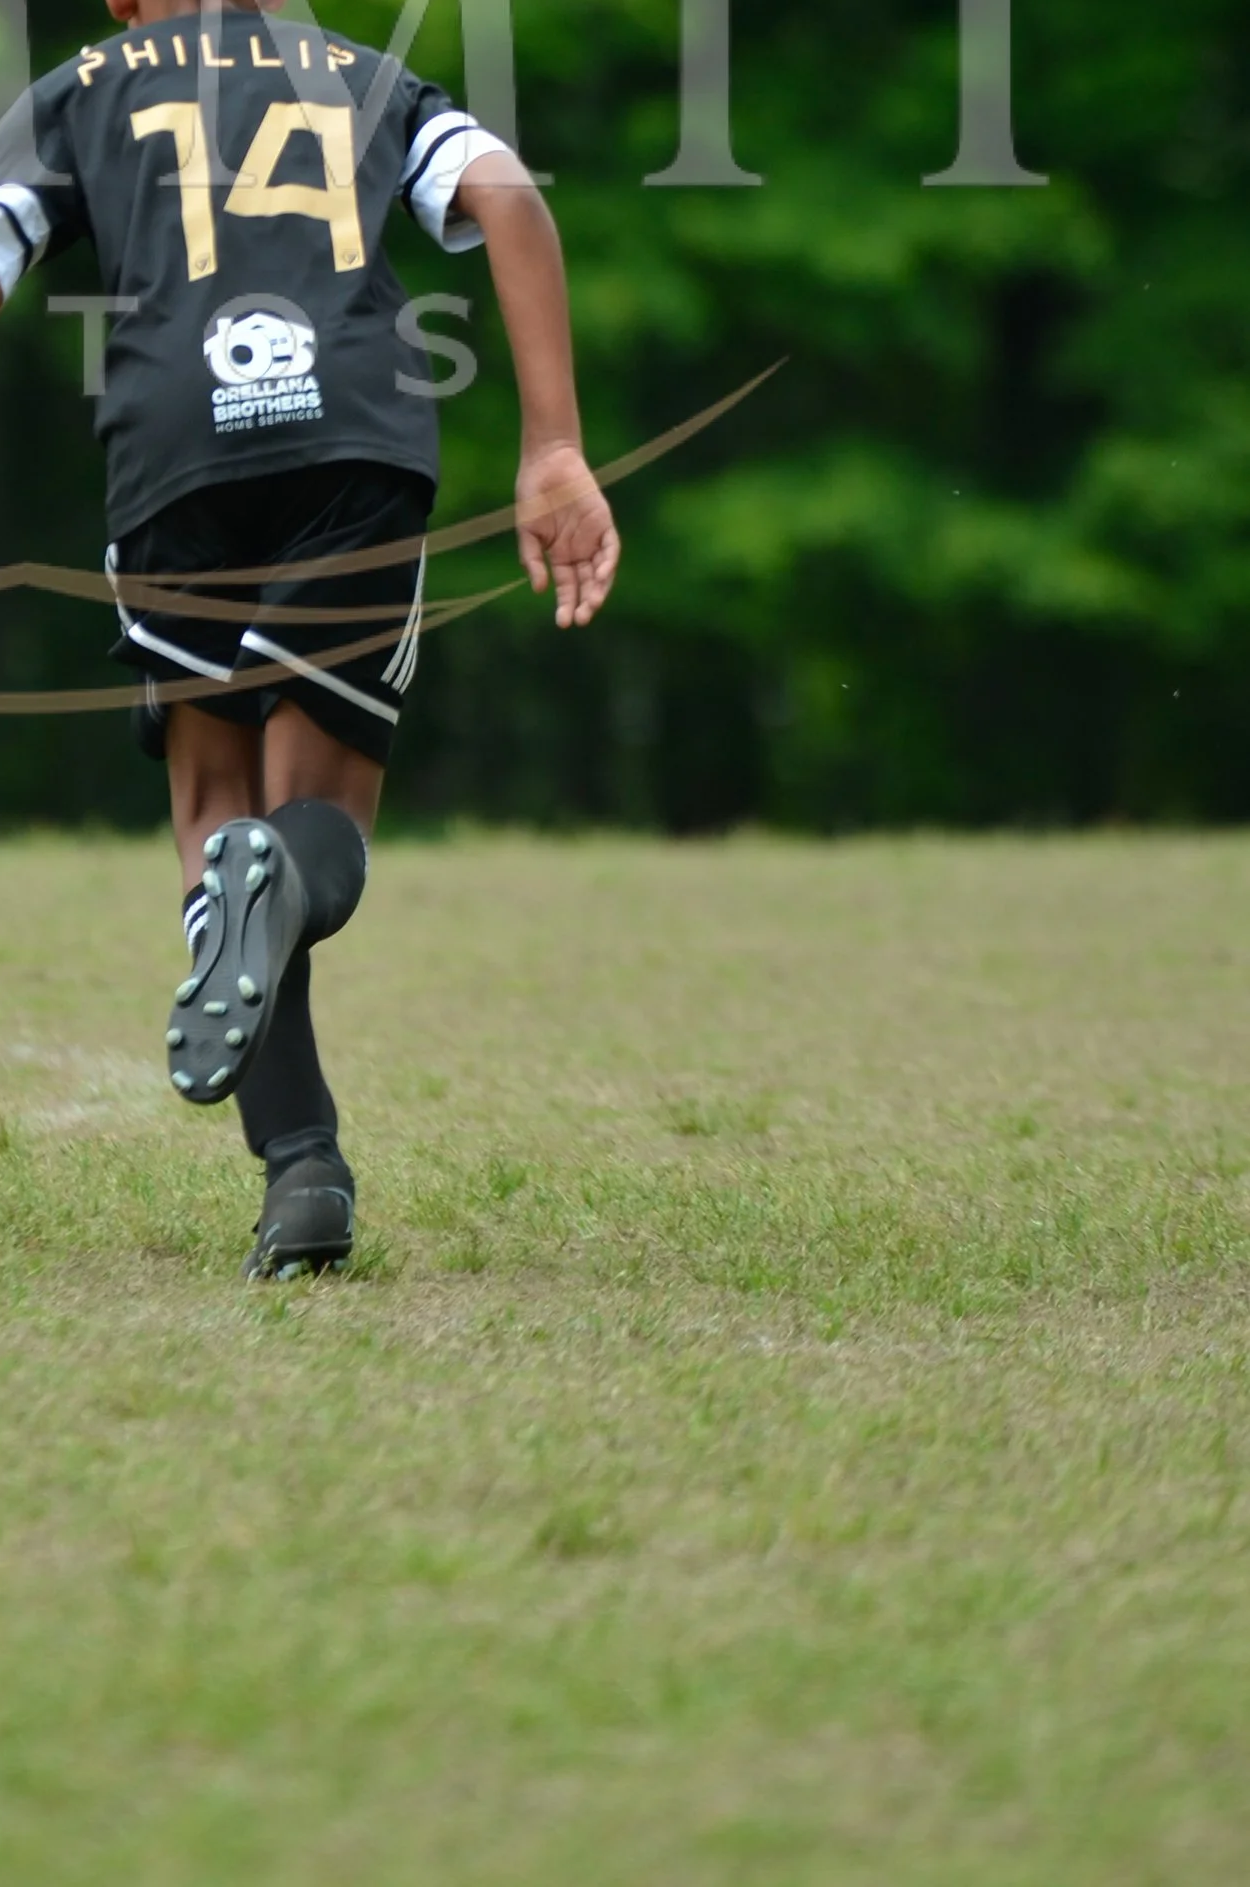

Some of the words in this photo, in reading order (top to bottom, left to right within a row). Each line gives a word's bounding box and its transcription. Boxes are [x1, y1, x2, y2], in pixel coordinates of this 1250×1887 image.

[76, 32, 356, 87] PHILLIP
[130, 101, 366, 282] 14
[211, 375, 319, 405] ORELLANA
[213, 391, 323, 423] BROTHERS
[215, 416, 254, 434] HOME
[258, 407, 325, 427] SERVICES
